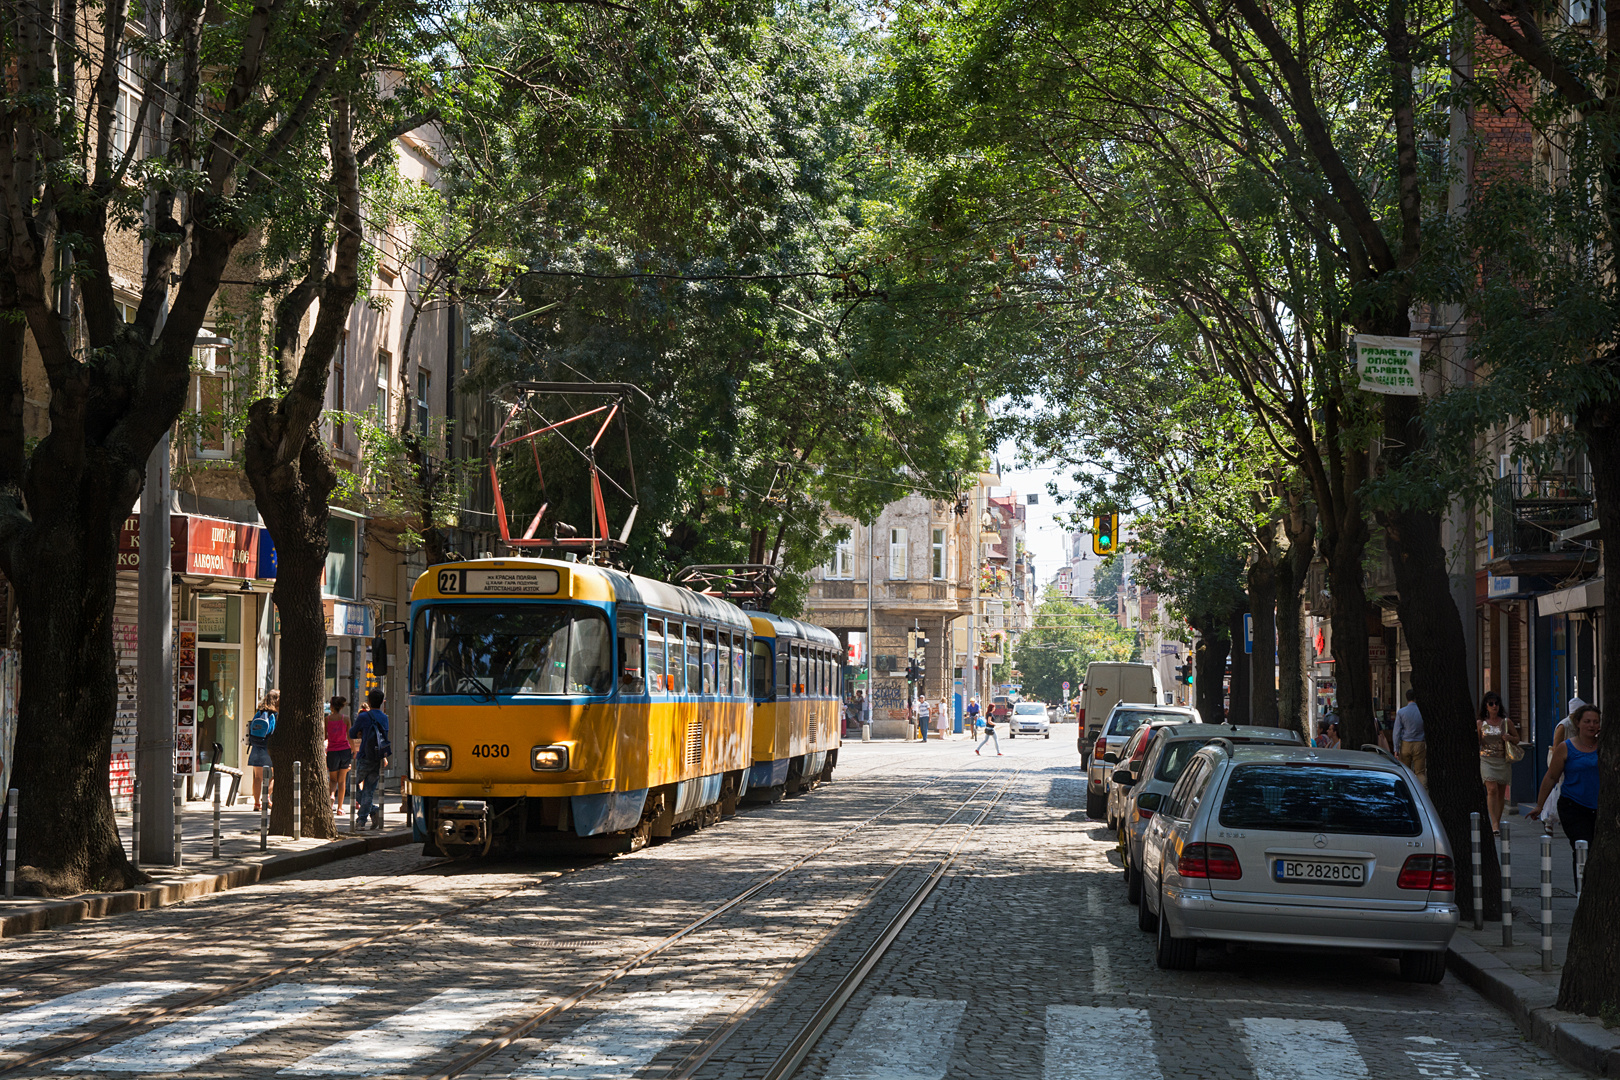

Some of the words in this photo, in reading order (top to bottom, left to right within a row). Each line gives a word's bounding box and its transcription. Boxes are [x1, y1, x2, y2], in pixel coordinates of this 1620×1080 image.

[1361, 347, 1397, 357] РЯЗАНЕ
[1400, 349, 1413, 357] НА
[1367, 357, 1407, 366] ОПАСНИ
[1364, 366, 1410, 375] ДЪРВЕТА
[211, 527, 236, 550] ЦИГАРИ
[193, 553, 224, 573] АЛКОХОЛ
[440, 573, 457, 591] 22
[471, 744, 510, 758] 4030
